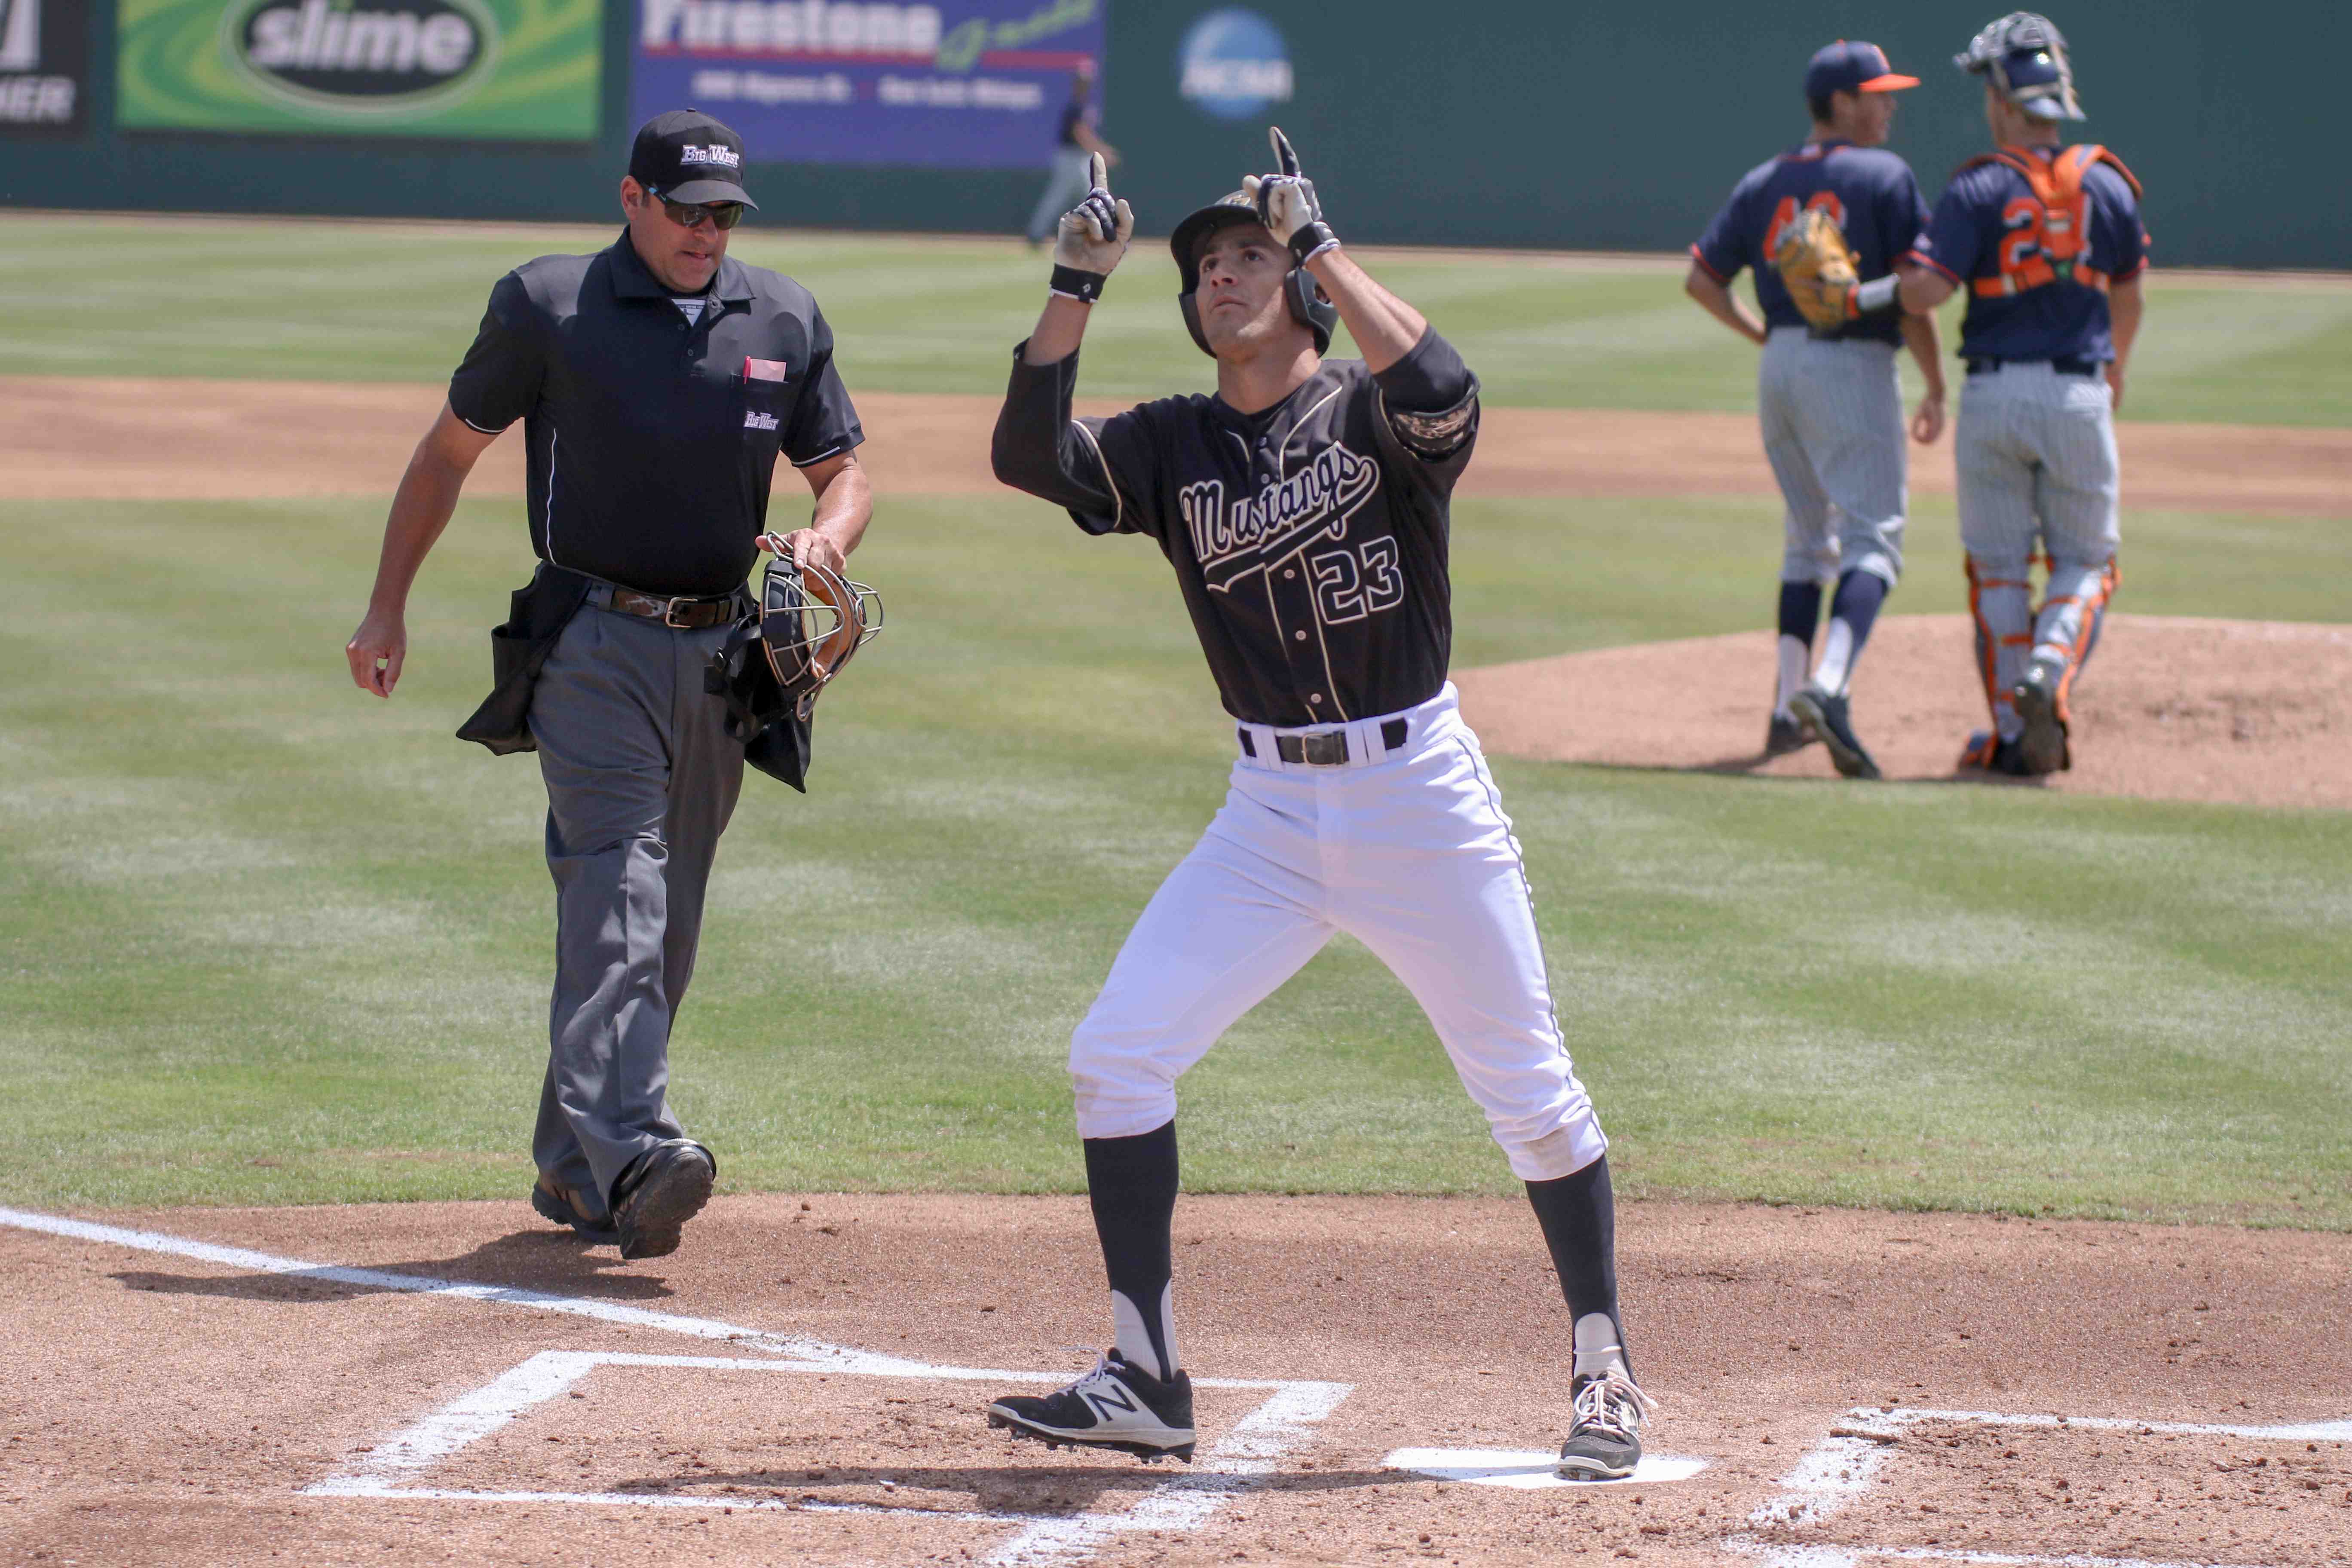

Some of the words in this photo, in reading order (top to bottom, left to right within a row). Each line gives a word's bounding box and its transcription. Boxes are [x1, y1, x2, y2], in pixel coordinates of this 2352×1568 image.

[251, 0, 473, 74] slime
[1179, 440, 1381, 563] Mustangs
[1311, 535, 1404, 624] 23
